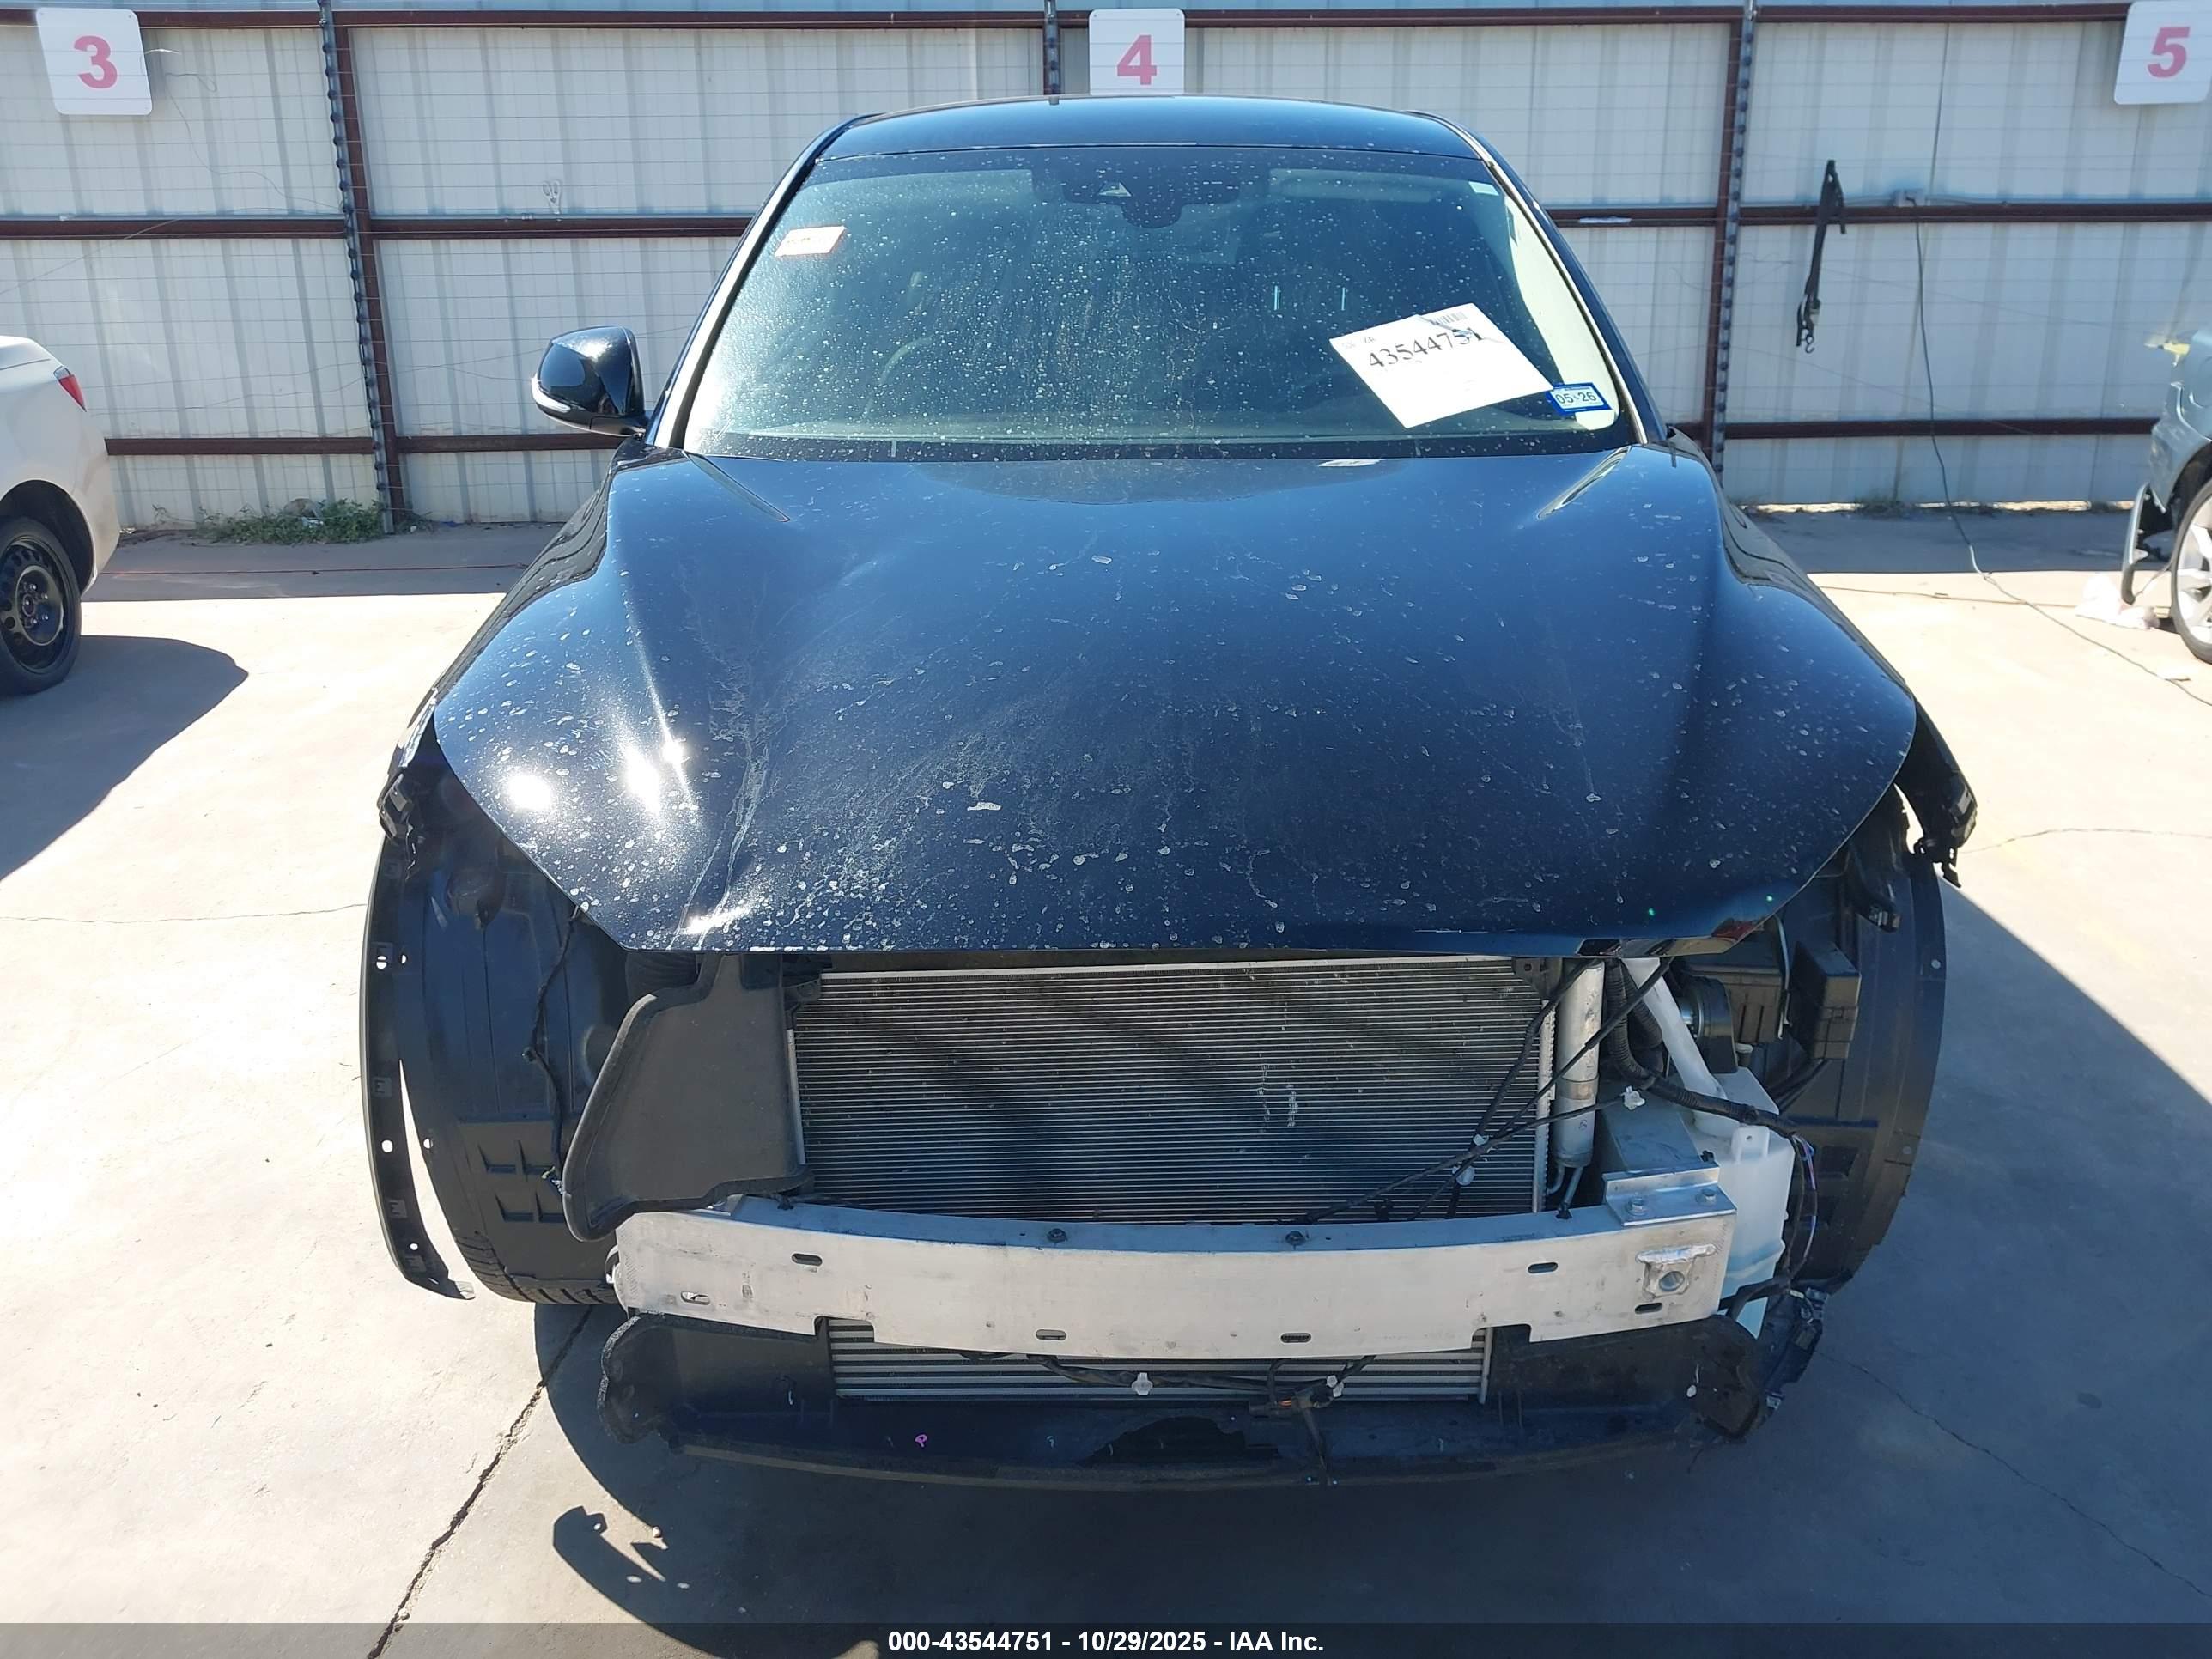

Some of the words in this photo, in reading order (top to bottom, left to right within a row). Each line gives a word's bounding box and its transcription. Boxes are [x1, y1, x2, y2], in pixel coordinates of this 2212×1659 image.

[73, 35, 118, 89] 3
[1116, 34, 1158, 85] 4
[2147, 27, 2191, 78] 5
[1369, 327, 1483, 367] 43544751
